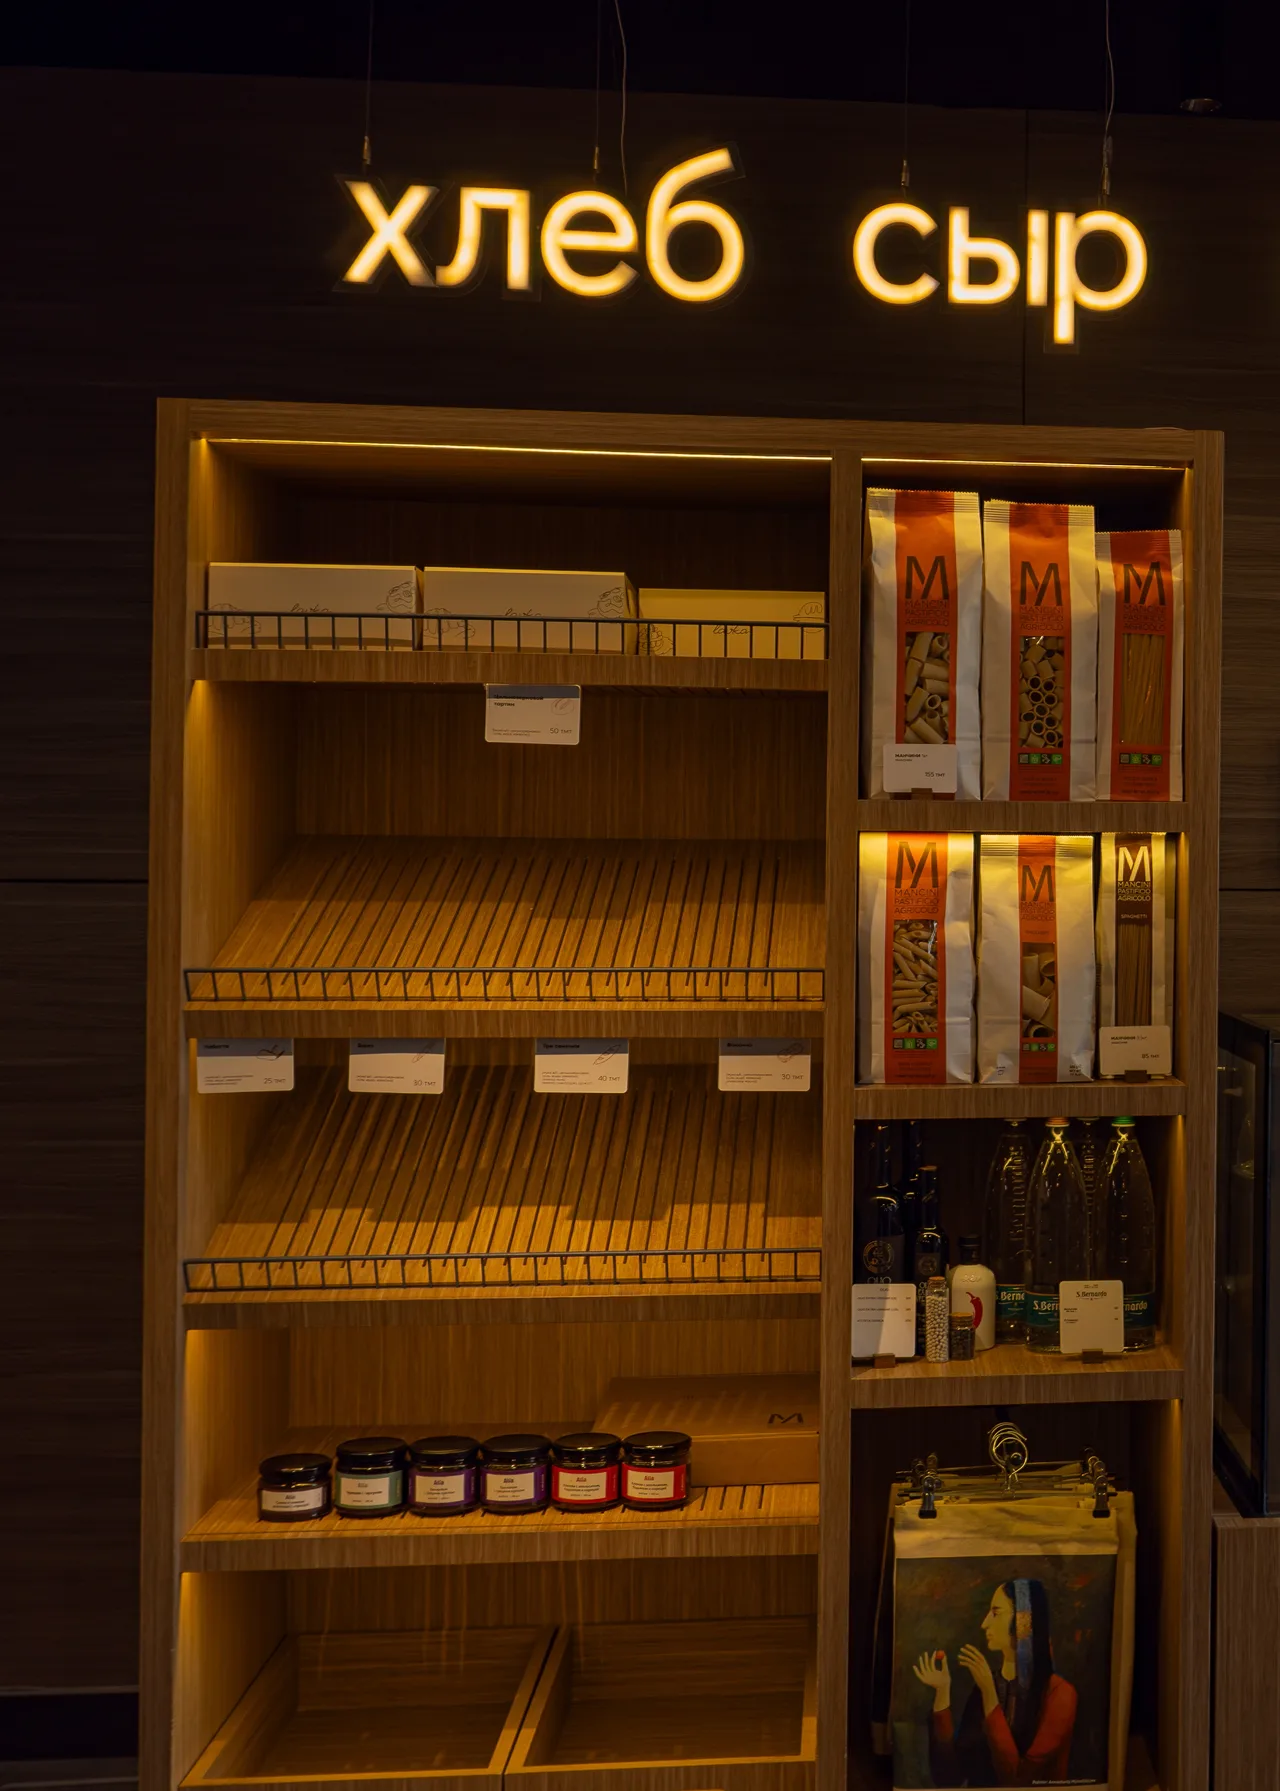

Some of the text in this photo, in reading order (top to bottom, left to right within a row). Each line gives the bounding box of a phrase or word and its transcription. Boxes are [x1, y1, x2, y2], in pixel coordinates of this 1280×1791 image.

[343, 146, 745, 302] хлеб
[852, 202, 1148, 345] сыр
[894, 889, 938, 897] MANCINI
